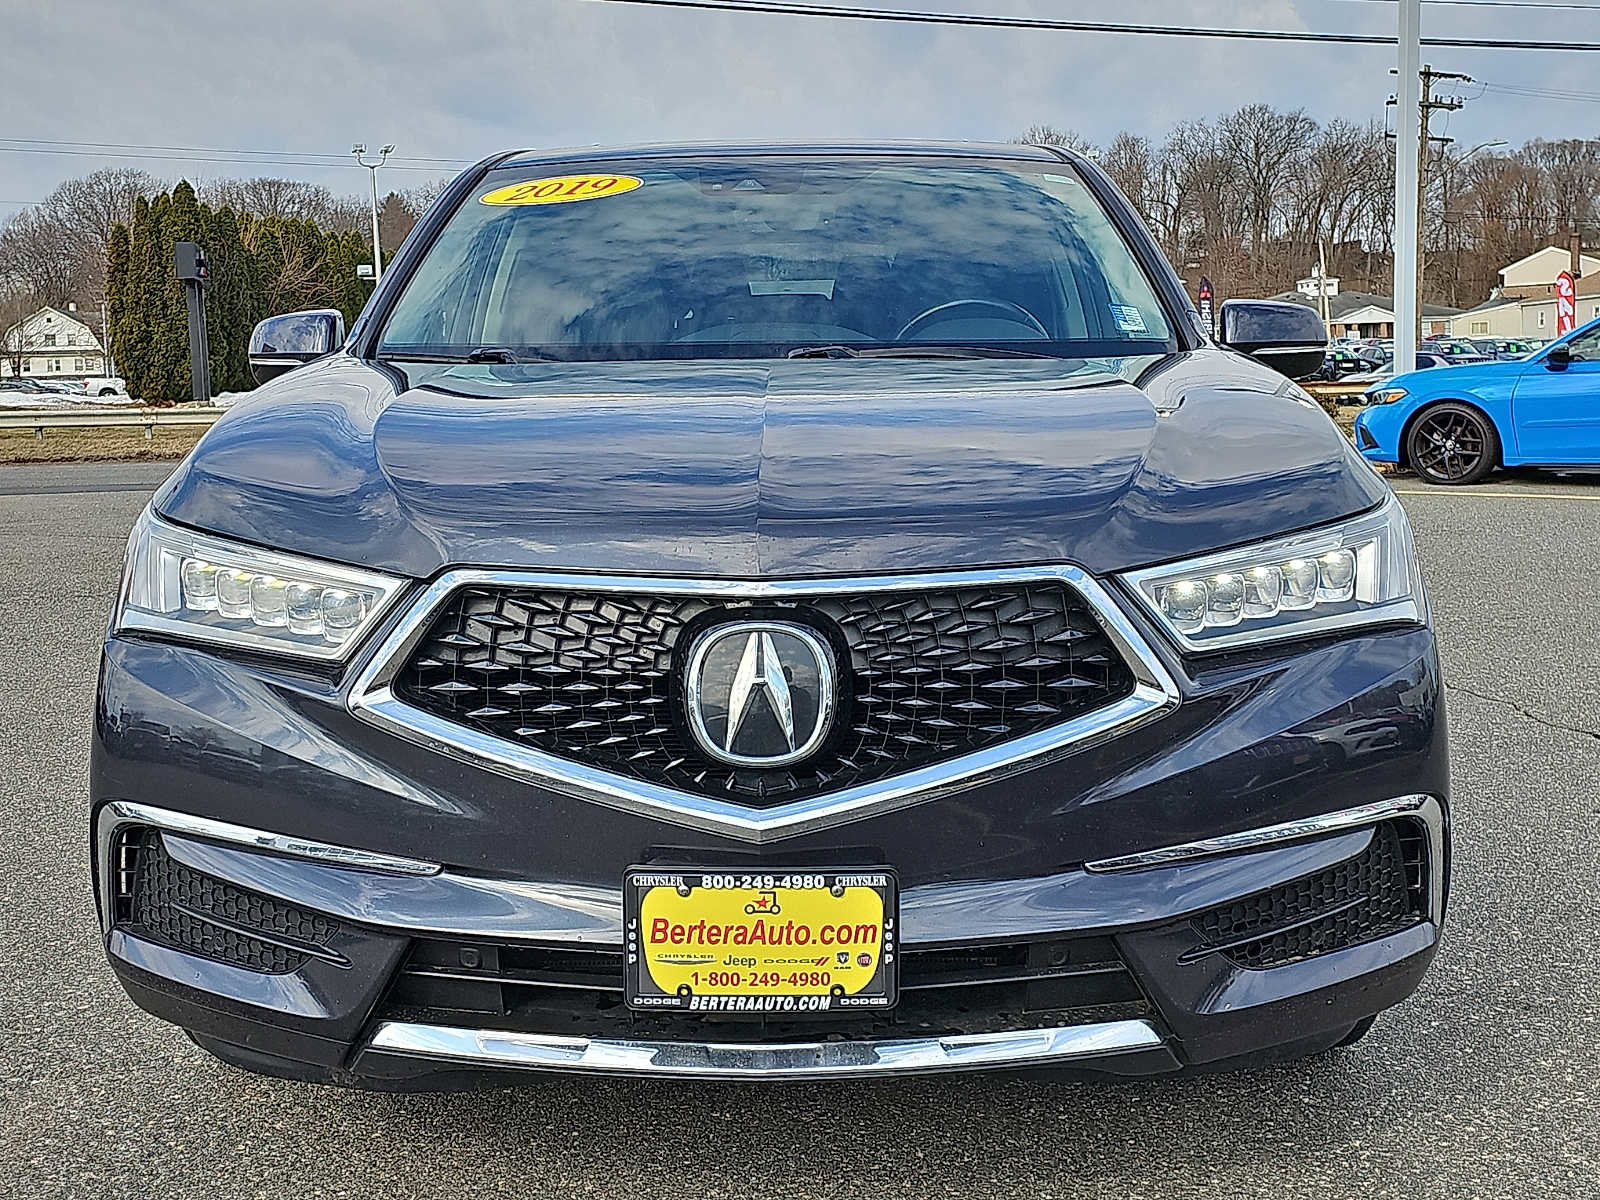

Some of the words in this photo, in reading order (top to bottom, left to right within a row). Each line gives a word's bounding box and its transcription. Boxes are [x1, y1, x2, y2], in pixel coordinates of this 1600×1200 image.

[504, 178, 618, 202] 2019
[633, 875, 684, 887] CHRYSLER
[701, 875, 825, 889] 800-249-4980
[835, 875, 887, 887] CHRYSLER
[628, 918, 637, 965] Jeep
[650, 918, 877, 946] BerteraAuto.com
[884, 918, 894, 965] Jeep
[723, 954, 757, 968] Jeep
[691, 972, 831, 987] 1-800-249-4980
[633, 997, 682, 1005] DODGE
[689, 996, 832, 1010] BERTERAAUTO.COM
[840, 997, 888, 1005] DODGE
